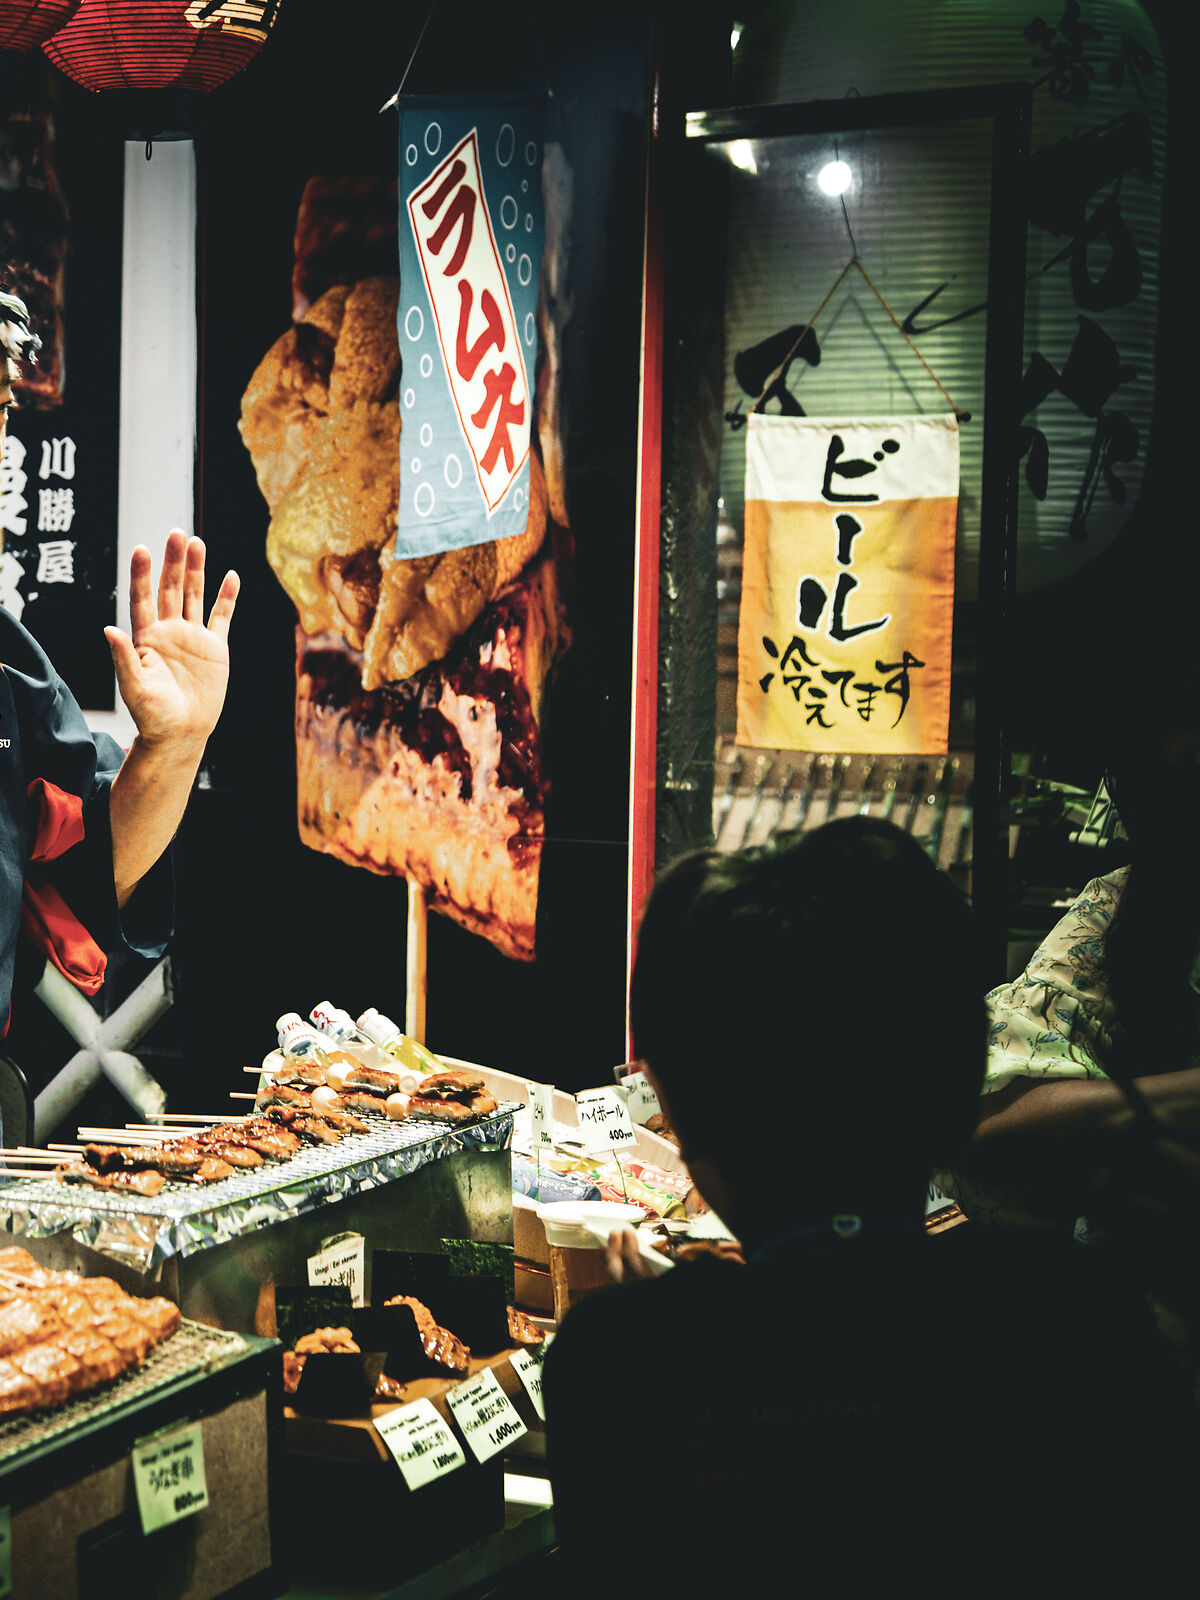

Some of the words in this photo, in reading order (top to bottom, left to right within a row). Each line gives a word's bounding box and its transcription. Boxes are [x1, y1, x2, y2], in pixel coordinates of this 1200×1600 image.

[421, 159, 525, 475] ラムネ
[36, 436, 76, 584] 川勝屋
[799, 435, 900, 642] ビール
[759, 635, 926, 729] 冷えてます
[581, 1104, 624, 1124] ハイボール
